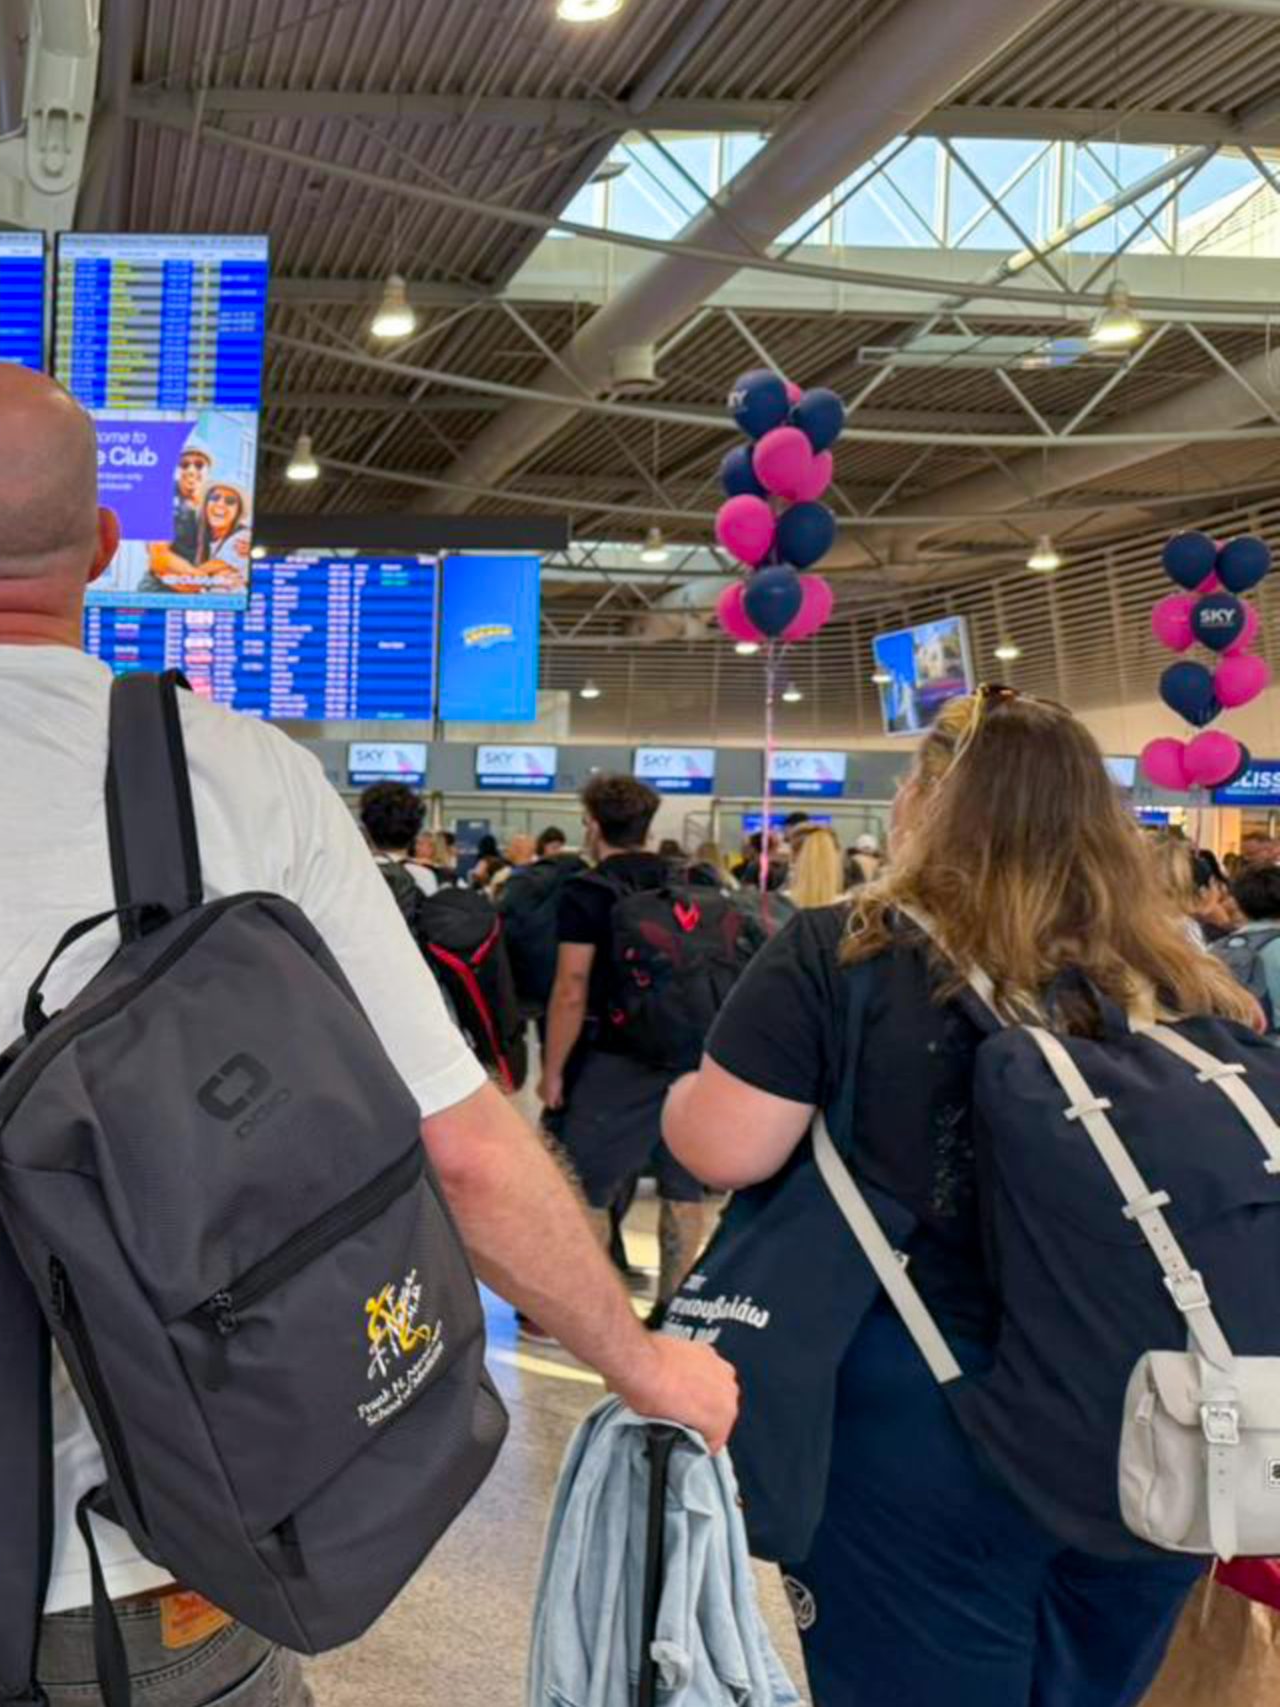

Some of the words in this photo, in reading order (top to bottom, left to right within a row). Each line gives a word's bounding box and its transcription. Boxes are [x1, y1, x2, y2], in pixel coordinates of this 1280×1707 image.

[131, 430, 147, 444] to
[108, 445, 159, 467] Club
[1200, 608, 1236, 623] SKY
[355, 749, 385, 762] SKY
[484, 751, 513, 765] SKY
[642, 753, 672, 767] SKY
[775, 756, 805, 770] SKY
